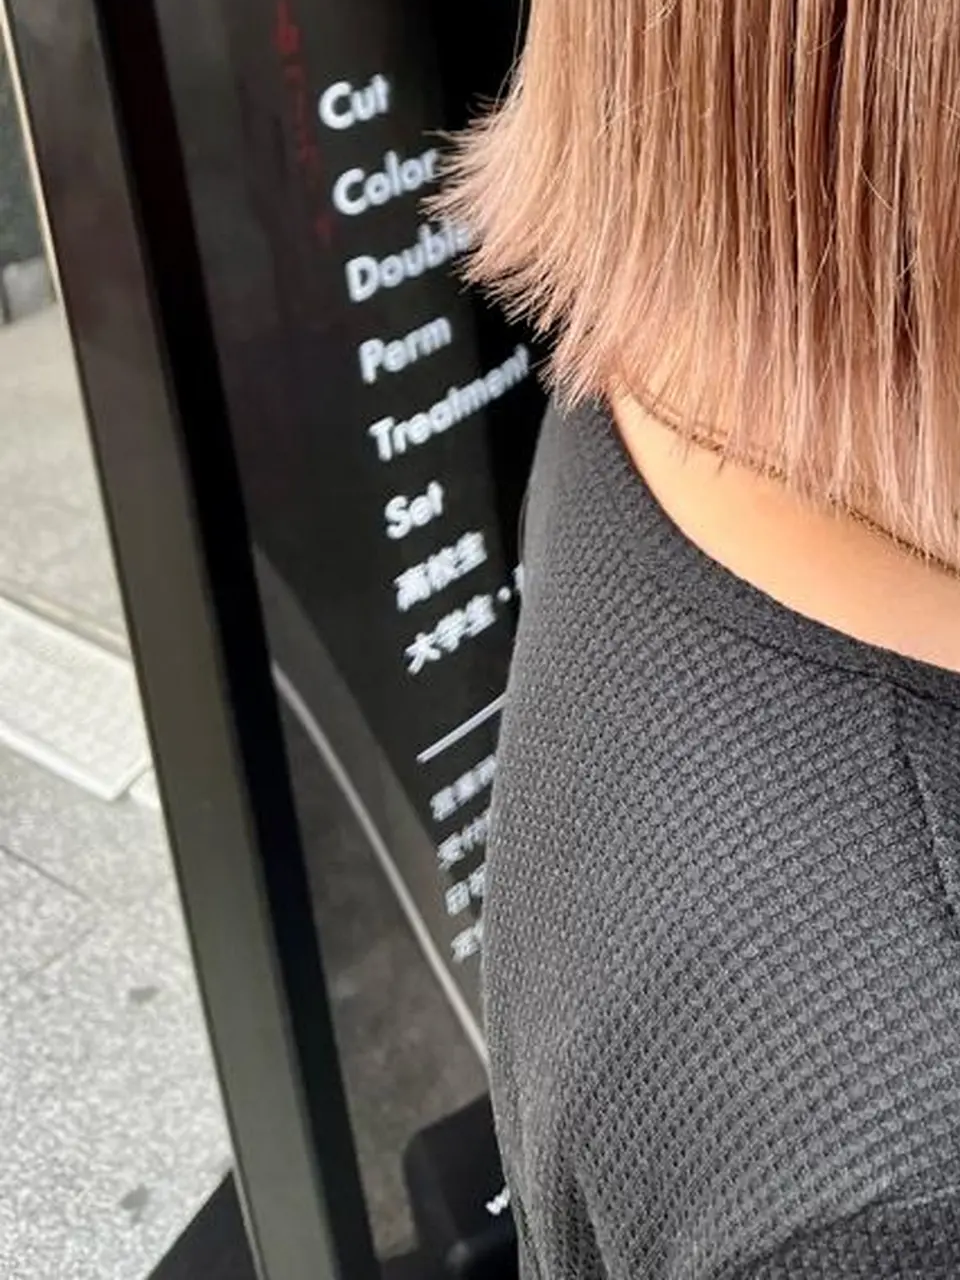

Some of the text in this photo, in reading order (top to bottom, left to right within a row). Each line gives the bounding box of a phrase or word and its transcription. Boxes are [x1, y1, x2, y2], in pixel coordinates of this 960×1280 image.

[319, 73, 391, 130] Cut
[332, 149, 440, 216] Color
[359, 317, 452, 384] Perm
[369, 343, 529, 461] Treatment
[385, 480, 443, 539] Set
